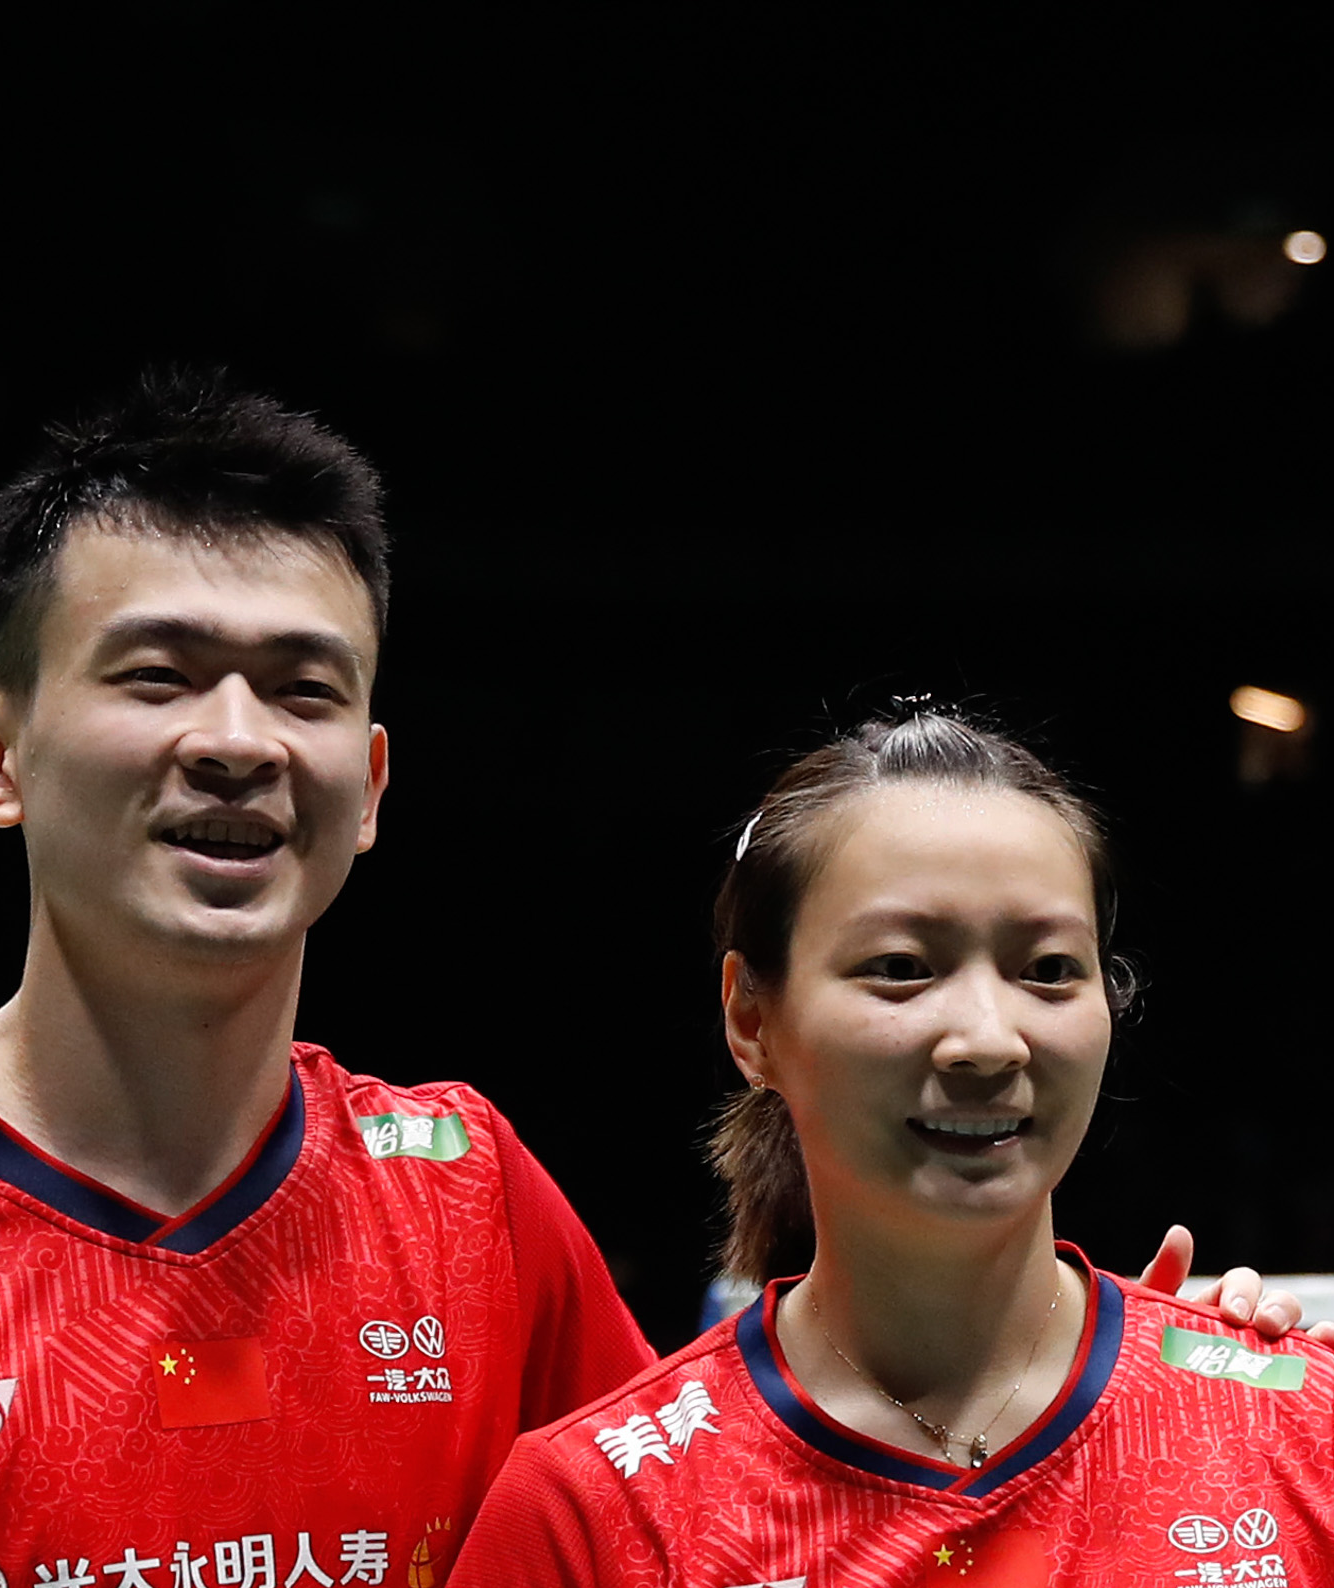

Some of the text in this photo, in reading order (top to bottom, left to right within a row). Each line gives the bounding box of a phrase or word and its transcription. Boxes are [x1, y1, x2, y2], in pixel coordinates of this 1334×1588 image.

[367, 1367, 452, 1391] 一汽-大众
[369, 1391, 452, 1404] FAW-VOLKSWAGEN
[1174, 1554, 1285, 1585] 一汽-大众
